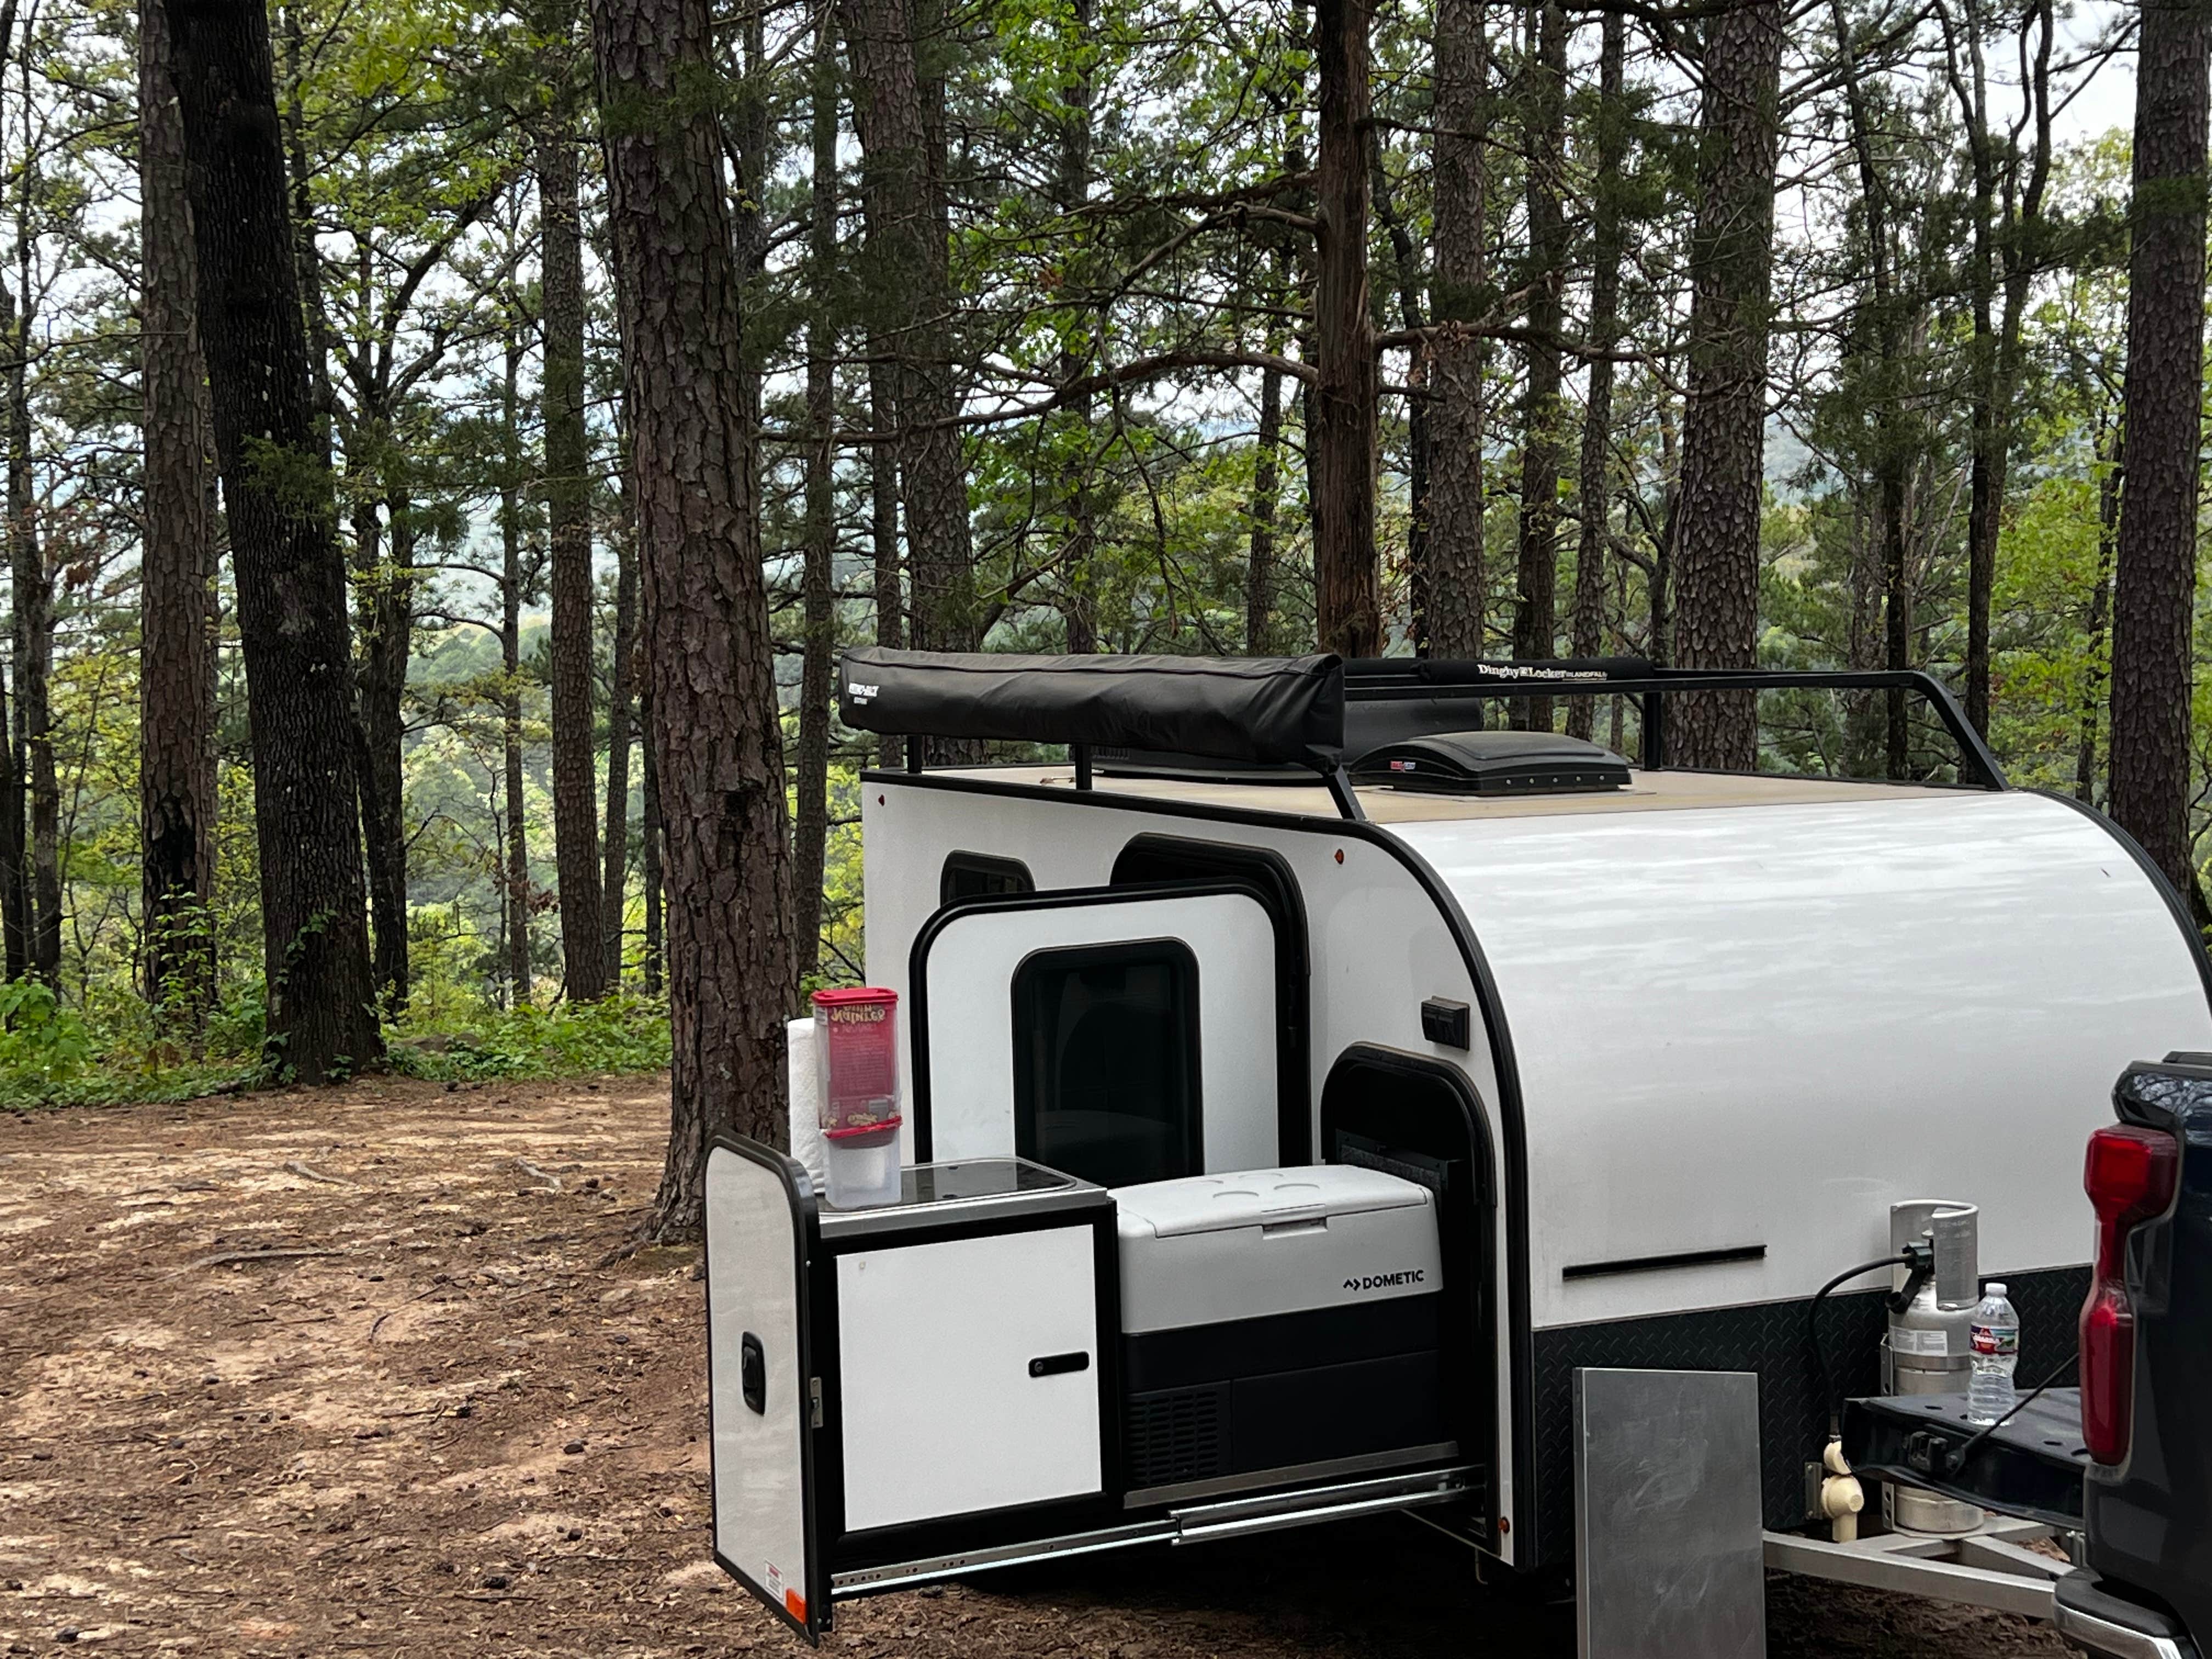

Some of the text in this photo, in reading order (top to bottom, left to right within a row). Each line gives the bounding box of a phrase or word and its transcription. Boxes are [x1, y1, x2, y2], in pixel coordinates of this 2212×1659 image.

[1477, 664, 1519, 679] Dinghy
[1530, 667, 1566, 678] Locker
[1363, 1269, 1424, 1289] DOMETIC
